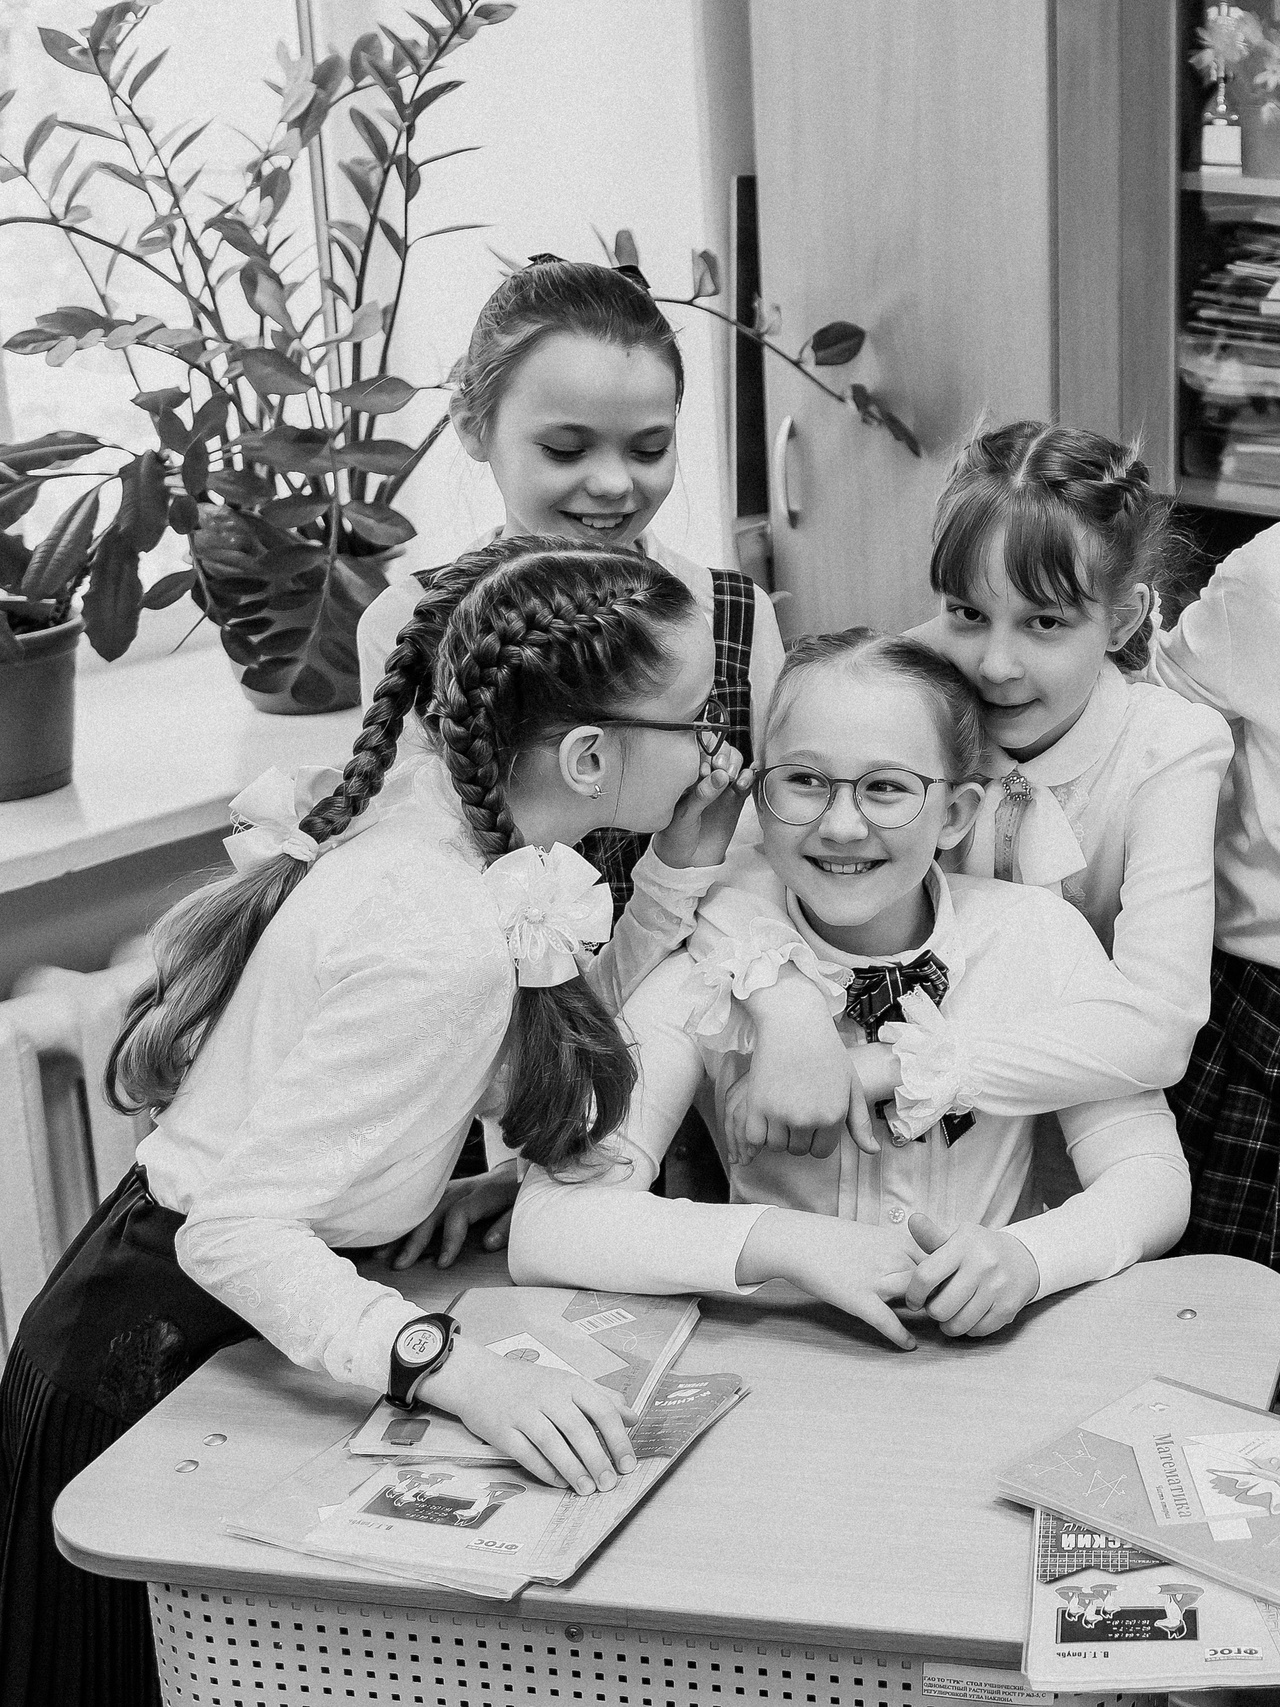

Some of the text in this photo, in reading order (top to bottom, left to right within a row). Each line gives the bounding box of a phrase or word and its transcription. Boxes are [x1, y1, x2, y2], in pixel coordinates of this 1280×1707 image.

[1152, 1431, 1193, 1518] Математика
[473, 1538, 518, 1550] ФГОС
[1061, 1533, 1131, 1550] СКИЙ
[1209, 1648, 1257, 1656] ФГОС
[923, 1682, 967, 1691] ОДНОМЕСТНЫЙ
[923, 1689, 967, 1697] РЕГУЛИРОВКОЙ
